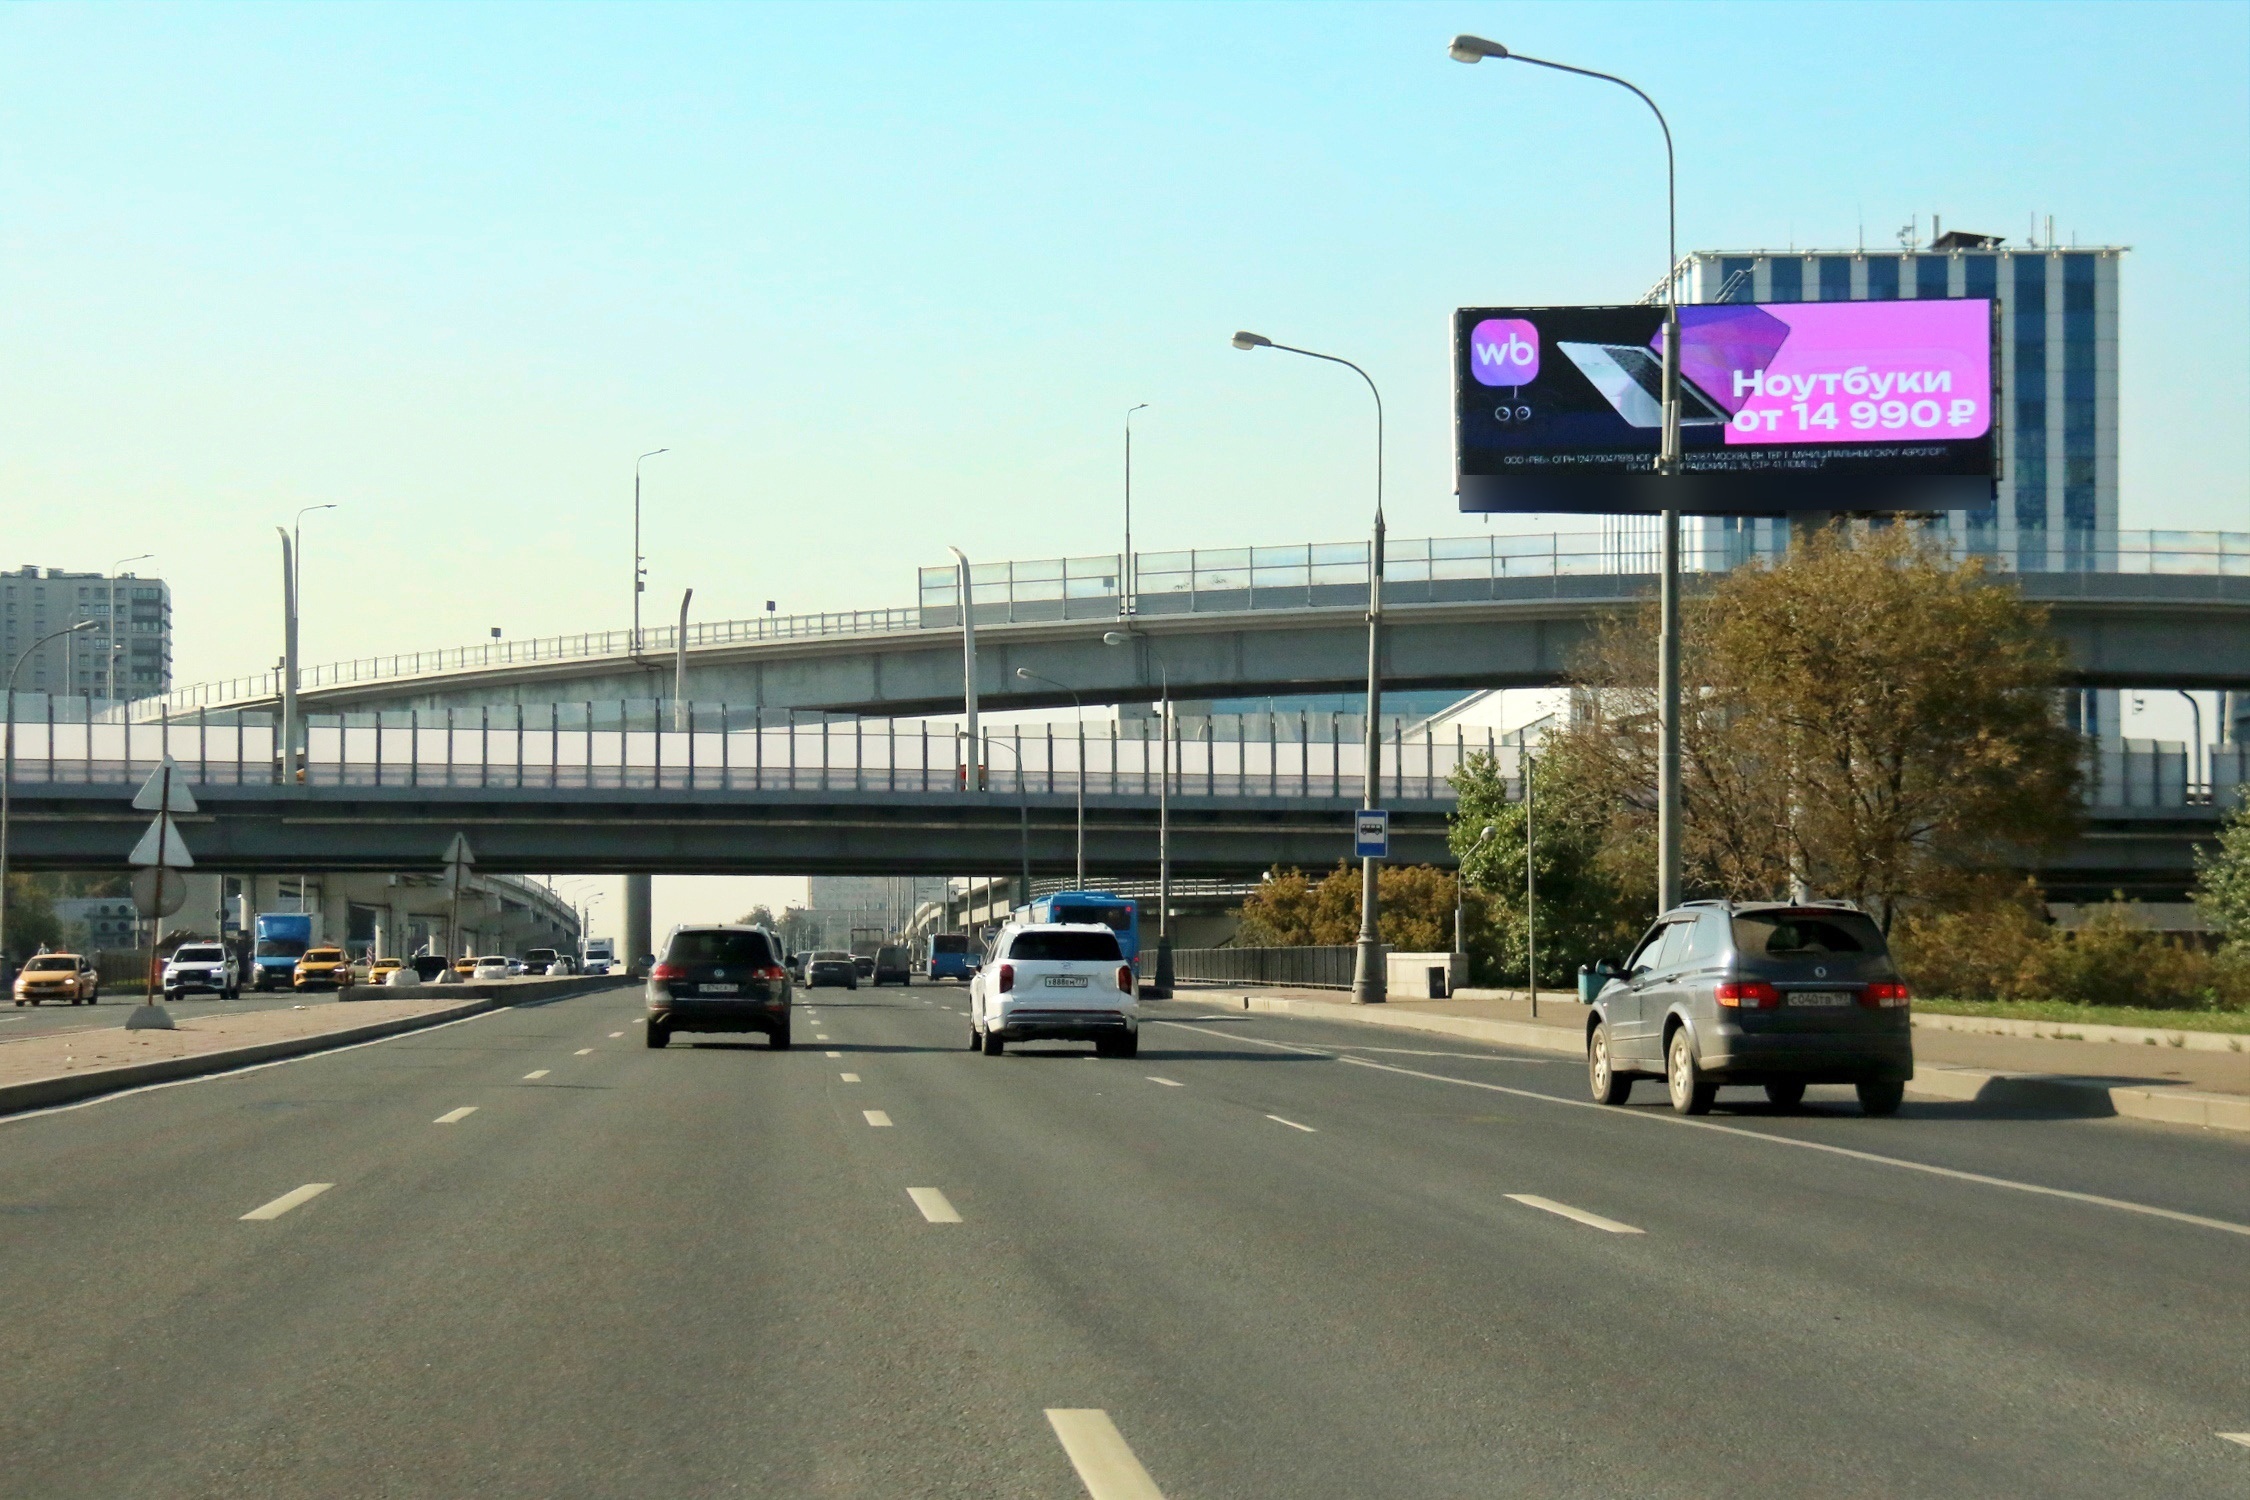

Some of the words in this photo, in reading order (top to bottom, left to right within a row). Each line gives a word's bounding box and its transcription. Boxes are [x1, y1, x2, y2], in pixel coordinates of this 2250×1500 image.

[1476, 333, 1534, 365] wb
[1733, 366, 1953, 401] Ноутбуки
[1732, 409, 1783, 432] от
[1791, 402, 1839, 430] 14
[1849, 400, 1941, 429] 990
